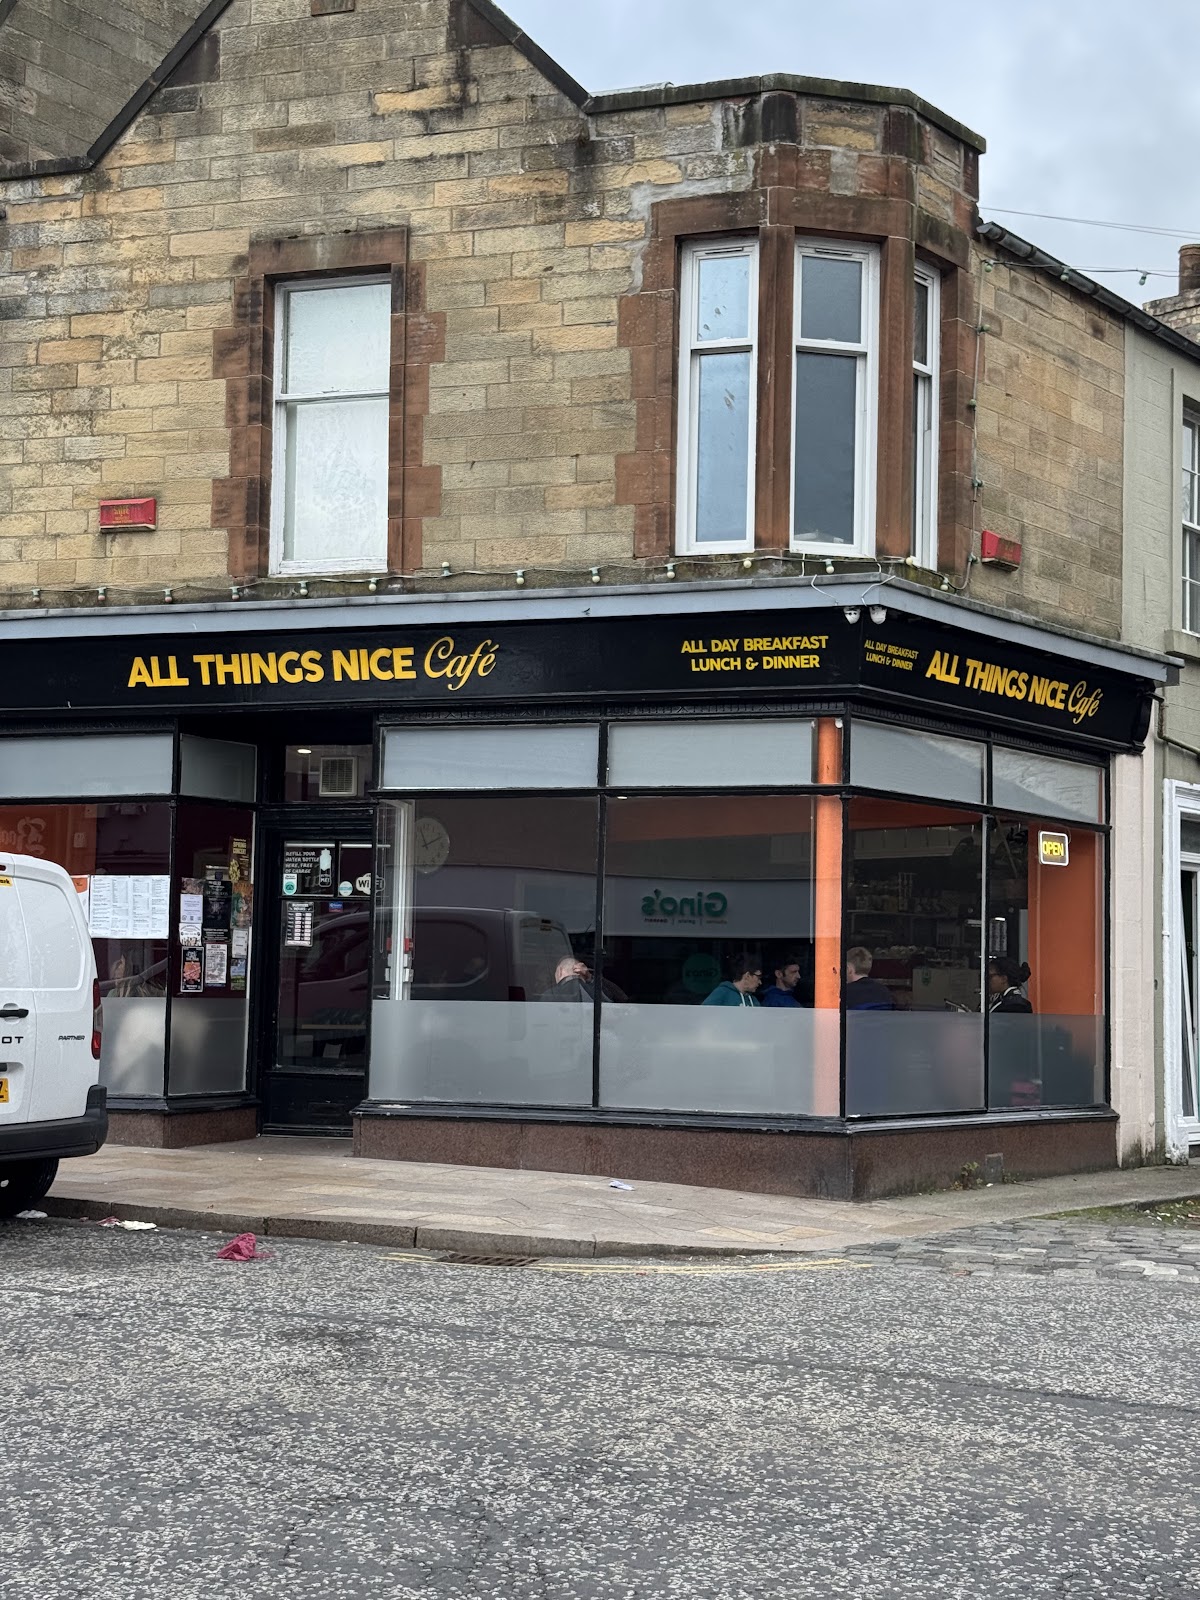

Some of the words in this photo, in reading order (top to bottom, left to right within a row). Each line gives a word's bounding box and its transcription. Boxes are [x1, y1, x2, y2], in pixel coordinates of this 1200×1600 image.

[681, 640, 707, 653] ALL
[711, 638, 740, 652] DAY
[743, 635, 829, 651] BREAKFAST
[864, 639, 875, 650] ALL
[875, 641, 888, 653] DAY
[887, 644, 920, 660] BREAKFAST
[127, 656, 190, 688] ALL
[193, 650, 325, 686] THINGS
[332, 647, 417, 682] NICE
[424, 636, 500, 691] Café
[691, 657, 742, 672] LUNCH
[745, 656, 759, 670] &
[762, 654, 821, 670] DINNER
[865, 652, 886, 666] LUNCH
[886, 656, 892, 666] &
[891, 658, 914, 671] DINNER
[925, 649, 961, 685] ALL
[964, 657, 1030, 701] THINGS
[1027, 675, 1070, 711] NICE
[1067, 680, 1104, 725] Café
[1042, 840, 1065, 857] OPEN
